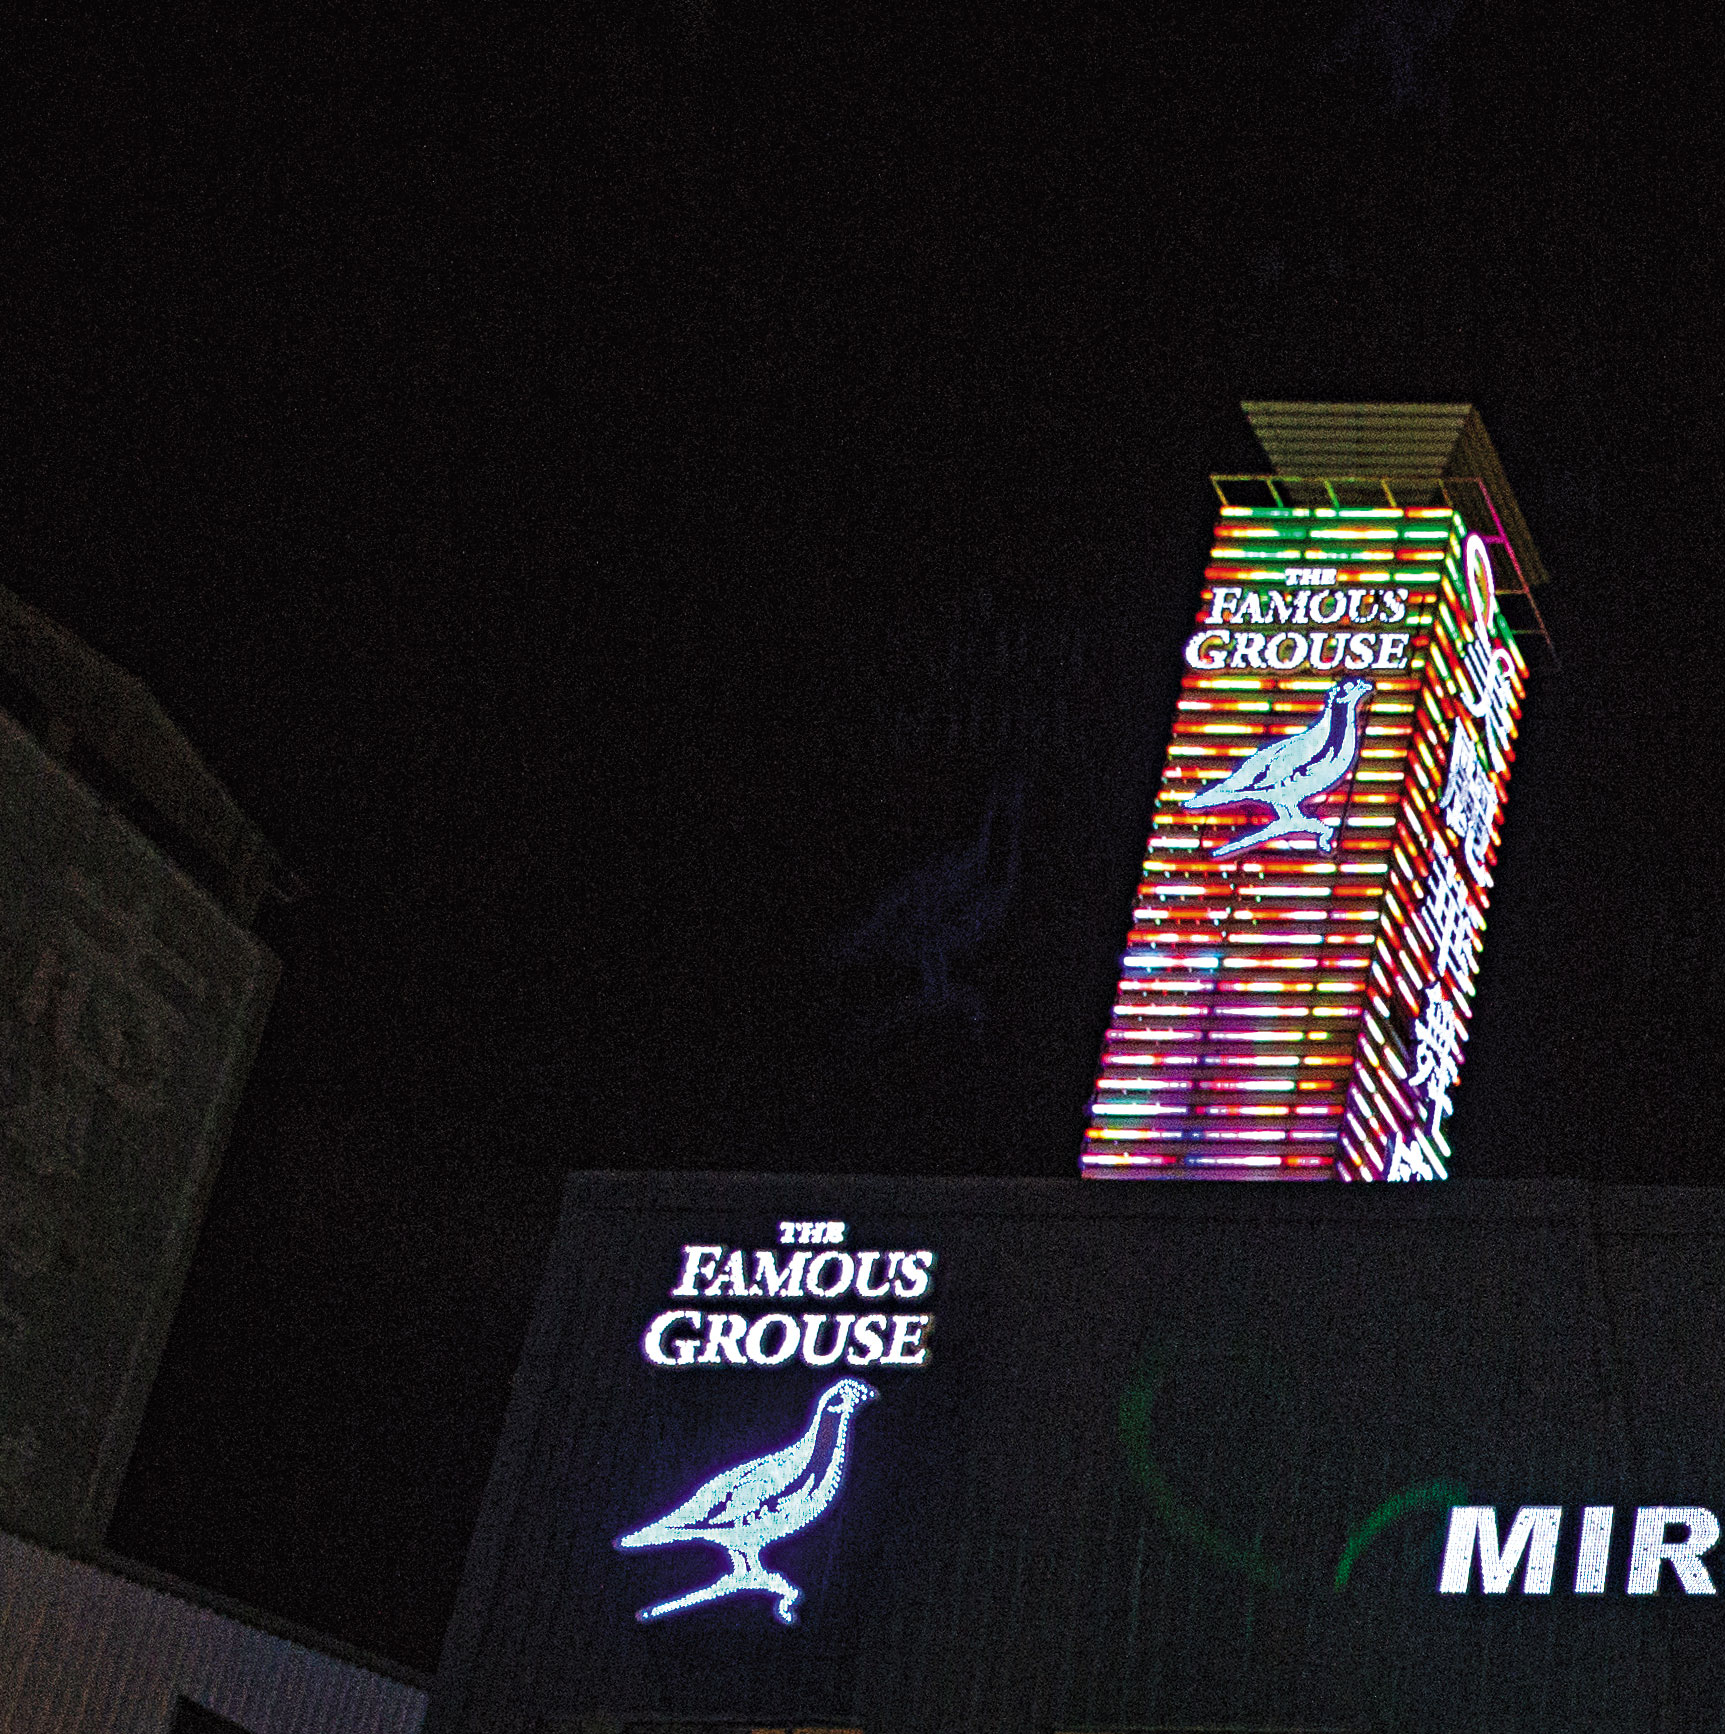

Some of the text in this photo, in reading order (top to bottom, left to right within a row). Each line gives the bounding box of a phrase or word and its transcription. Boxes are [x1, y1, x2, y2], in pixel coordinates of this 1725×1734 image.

[1284, 567, 1338, 587] THE
[1205, 586, 1410, 625] FAMOUS
[1184, 629, 1411, 672] GROUSE
[779, 1220, 846, 1244] THE
[671, 1245, 934, 1299] FAMOUS
[643, 1309, 930, 1367] GROUSE
